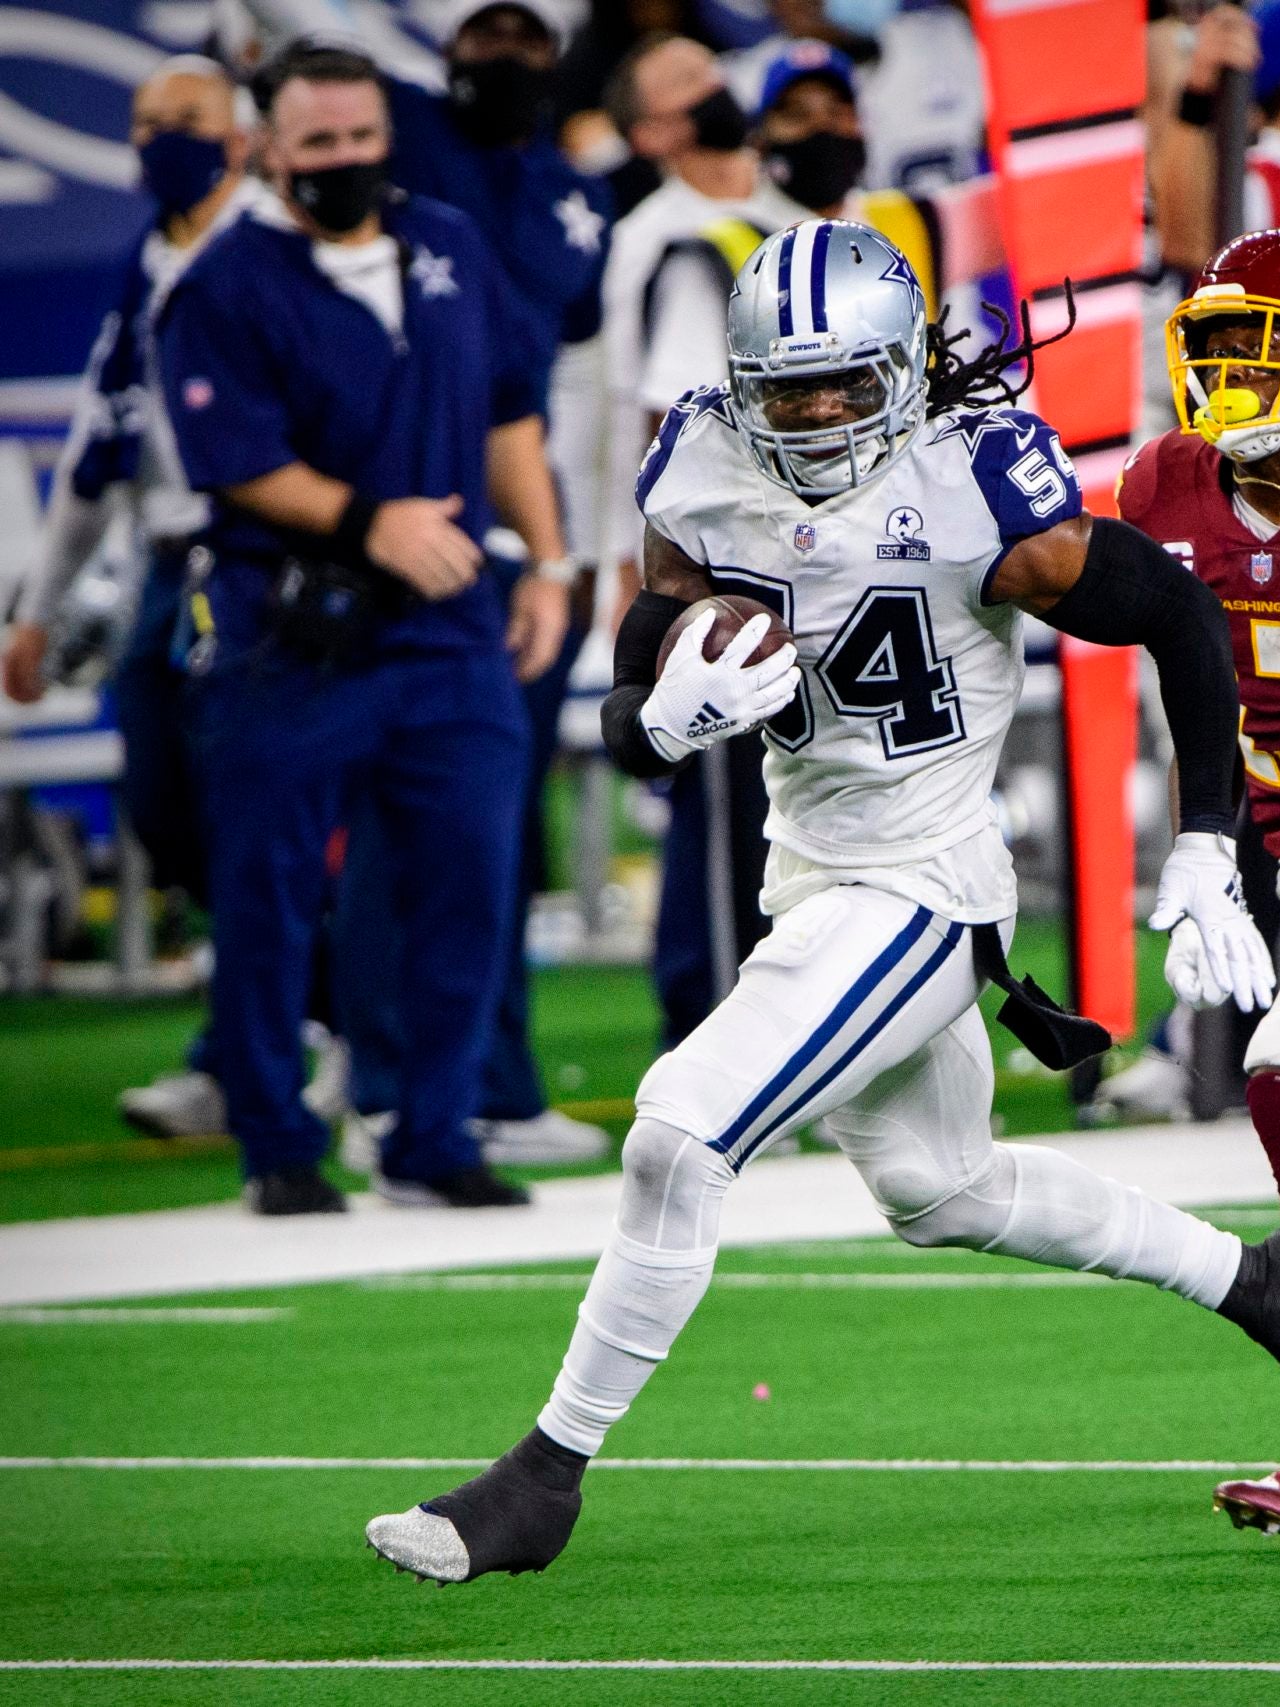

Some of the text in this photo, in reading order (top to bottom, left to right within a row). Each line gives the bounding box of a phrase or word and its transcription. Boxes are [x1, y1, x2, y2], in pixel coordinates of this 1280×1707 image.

[788, 342, 821, 352] COWBOYS
[878, 547, 929, 559] EST. 1960
[687, 720, 737, 738] adidas
